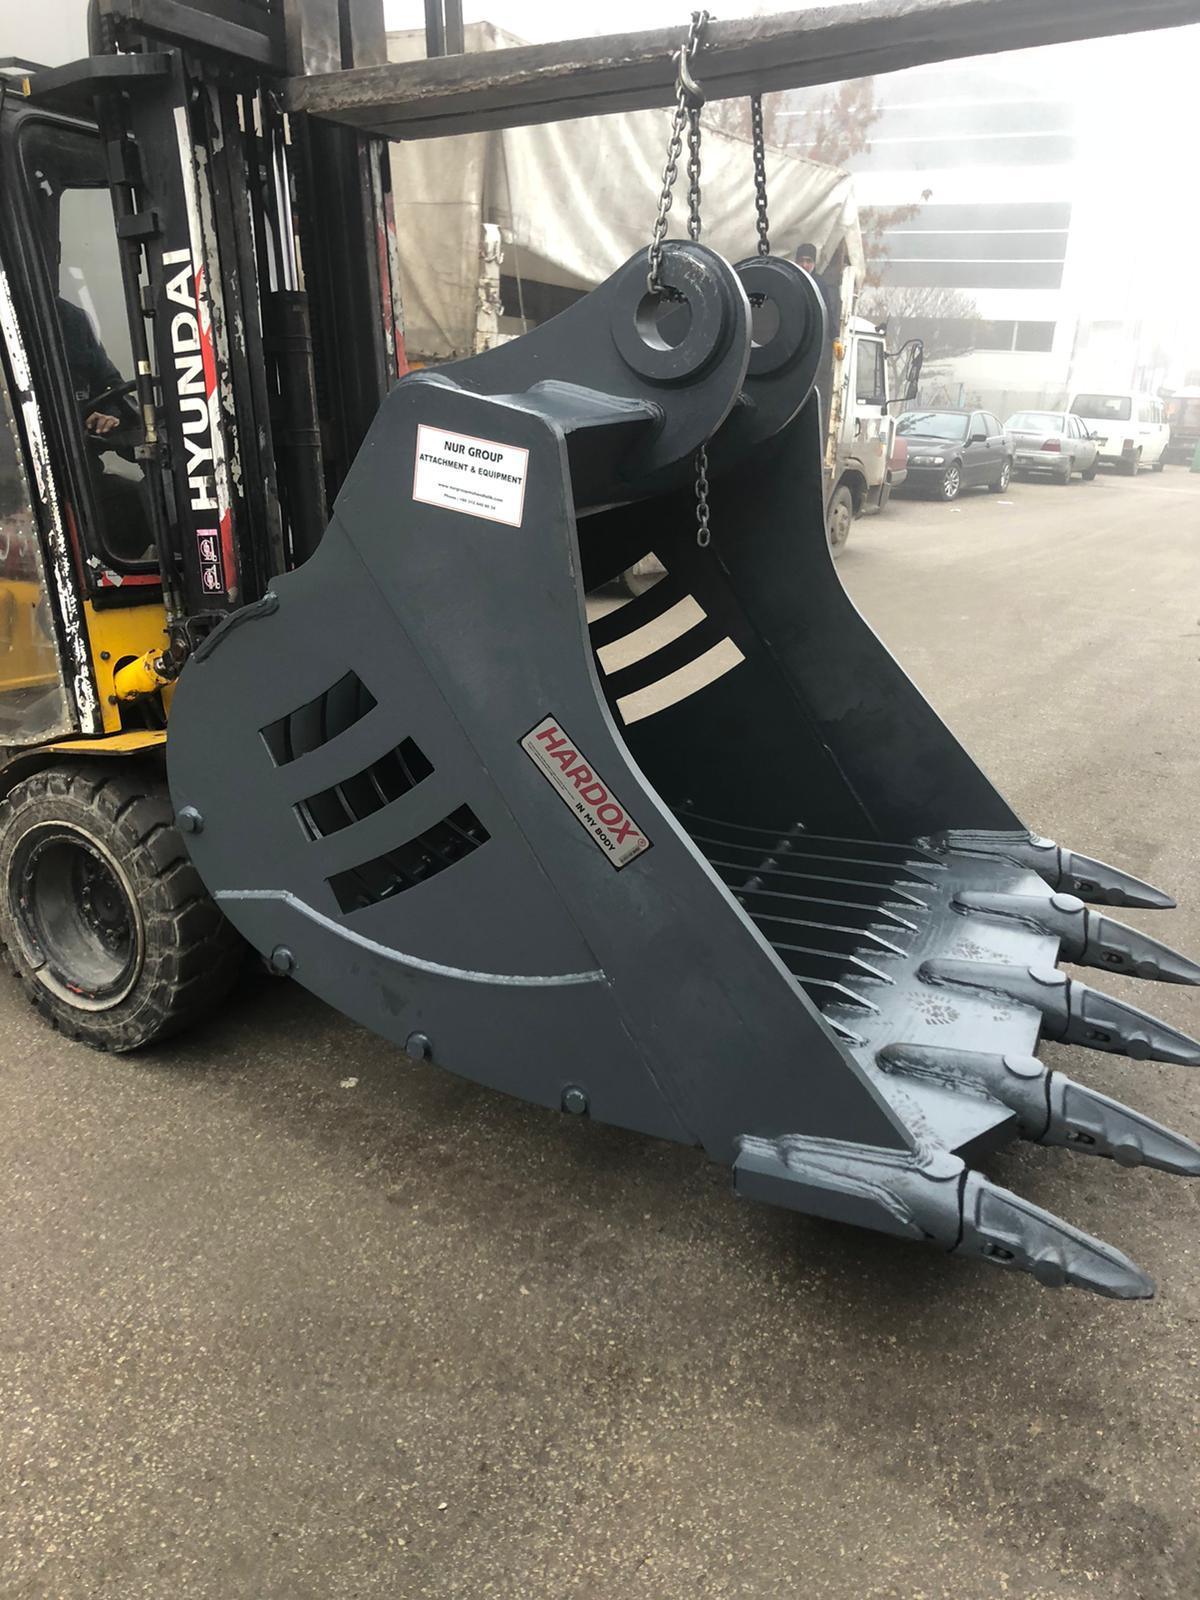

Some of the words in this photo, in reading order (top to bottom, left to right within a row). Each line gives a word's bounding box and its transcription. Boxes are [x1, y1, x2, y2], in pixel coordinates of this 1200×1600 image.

[162, 248, 219, 512] HYUNDAI
[419, 453, 469, 471] ATTACHMENT
[478, 467, 522, 485] EQUIPMENT
[444, 441, 465, 454] NUR
[468, 447, 503, 463] GROUP
[536, 726, 640, 845] HARDOX
[575, 802, 586, 814] IN
[583, 813, 597, 827] MY
[595, 827, 616, 851] BODY
